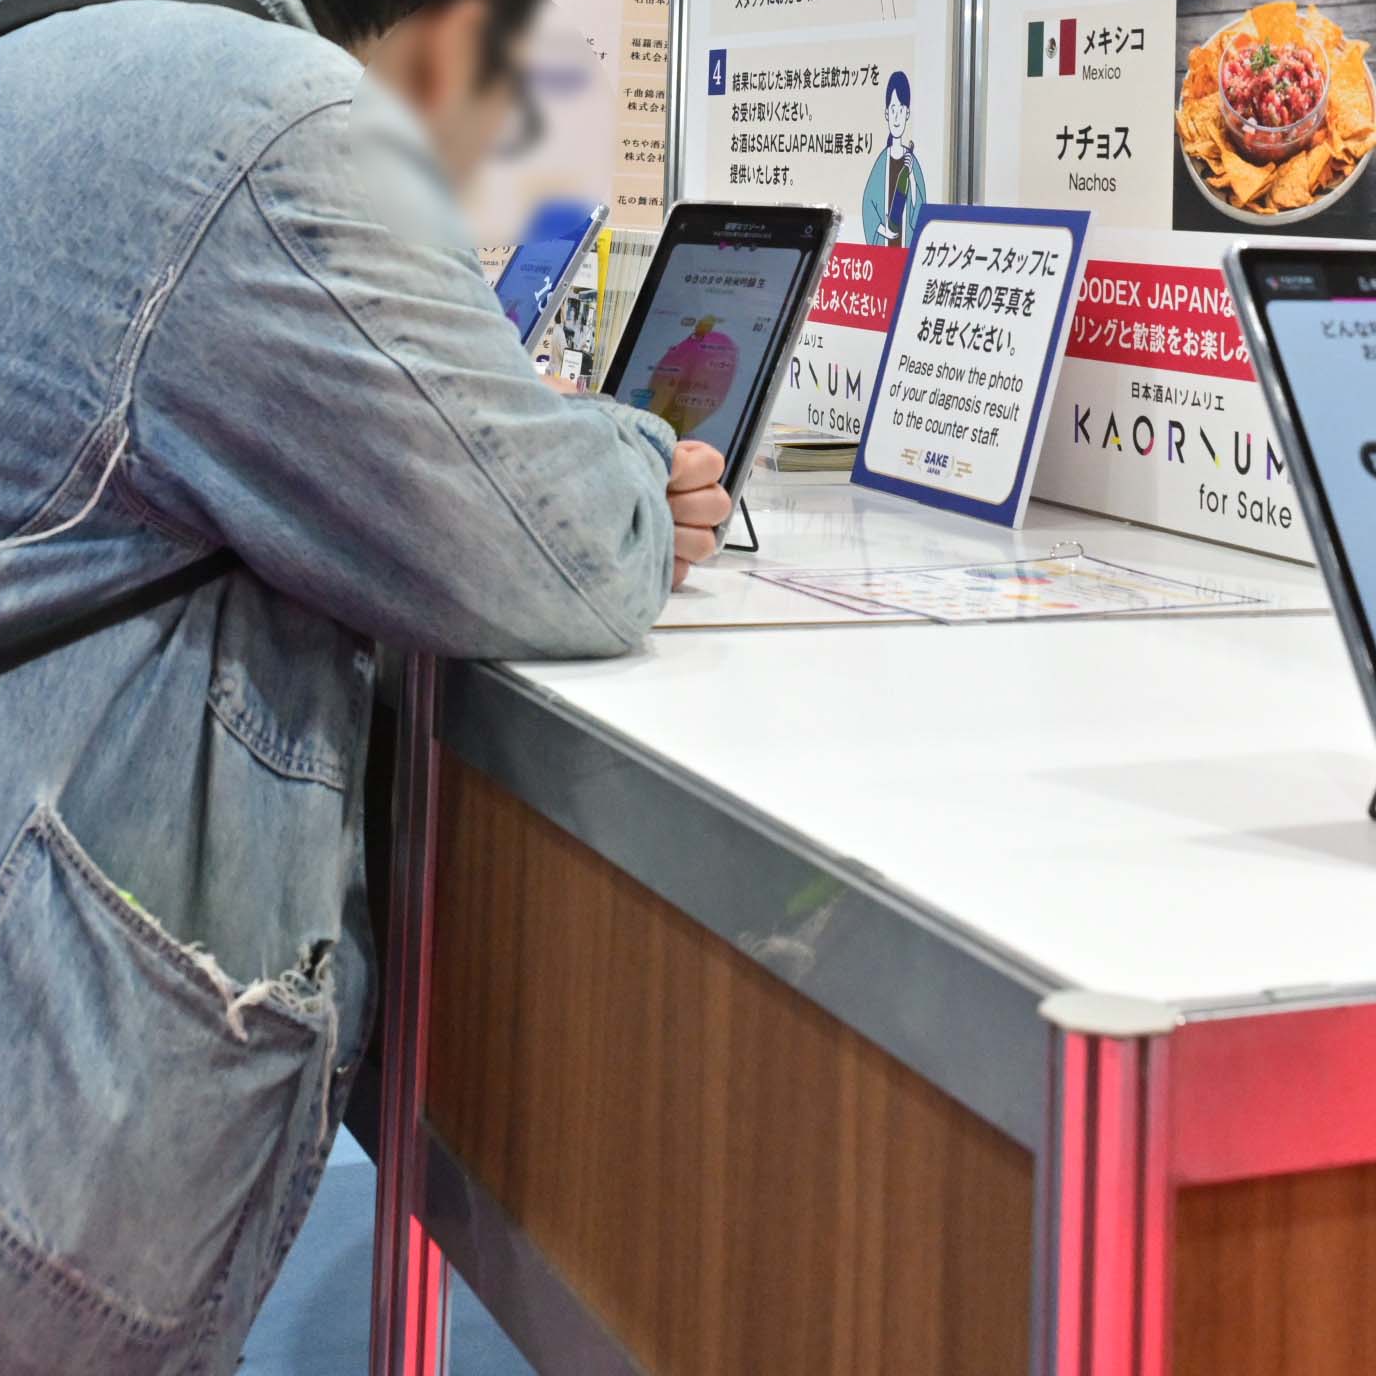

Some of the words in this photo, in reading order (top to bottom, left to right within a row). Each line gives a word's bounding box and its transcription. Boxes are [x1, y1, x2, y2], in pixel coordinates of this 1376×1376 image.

[1084, 27, 1144, 56] メキシコ
[732, 63, 880, 93] 結果に応じた海外食と試飲カップを
[1082, 65, 1121, 82] Mexico
[731, 101, 813, 123] お受け取りください。
[731, 132, 874, 155] お酒はSAKEJAPAN出展者より
[1056, 125, 1132, 161] ナチョス
[730, 164, 795, 187] 提供いたします。
[1069, 173, 1117, 192] Nachos
[922, 241, 1059, 277] カウンタースタッフに
[922, 278, 1036, 317] 診断結果の写真を
[917, 316, 1016, 356] お見せください。
[898, 354, 934, 377] Please
[936, 362, 965, 383] show
[967, 367, 986, 387] the
[988, 371, 1023, 393] photo
[889, 382, 901, 397] of
[902, 387, 927, 407] your
[929, 388, 981, 415] diagnosis
[984, 400, 1020, 423] result
[1131, 382, 1225, 412] 日本酒AIソムリエ
[808, 403, 824, 426] for
[830, 408, 861, 435] Sake
[893, 408, 904, 426] to
[906, 411, 923, 431] the
[925, 417, 969, 441] counter
[971, 426, 1000, 448] staff.
[924, 450, 949, 468] SAKE
[1199, 483, 1228, 515] for
[1237, 492, 1292, 529] Sake
